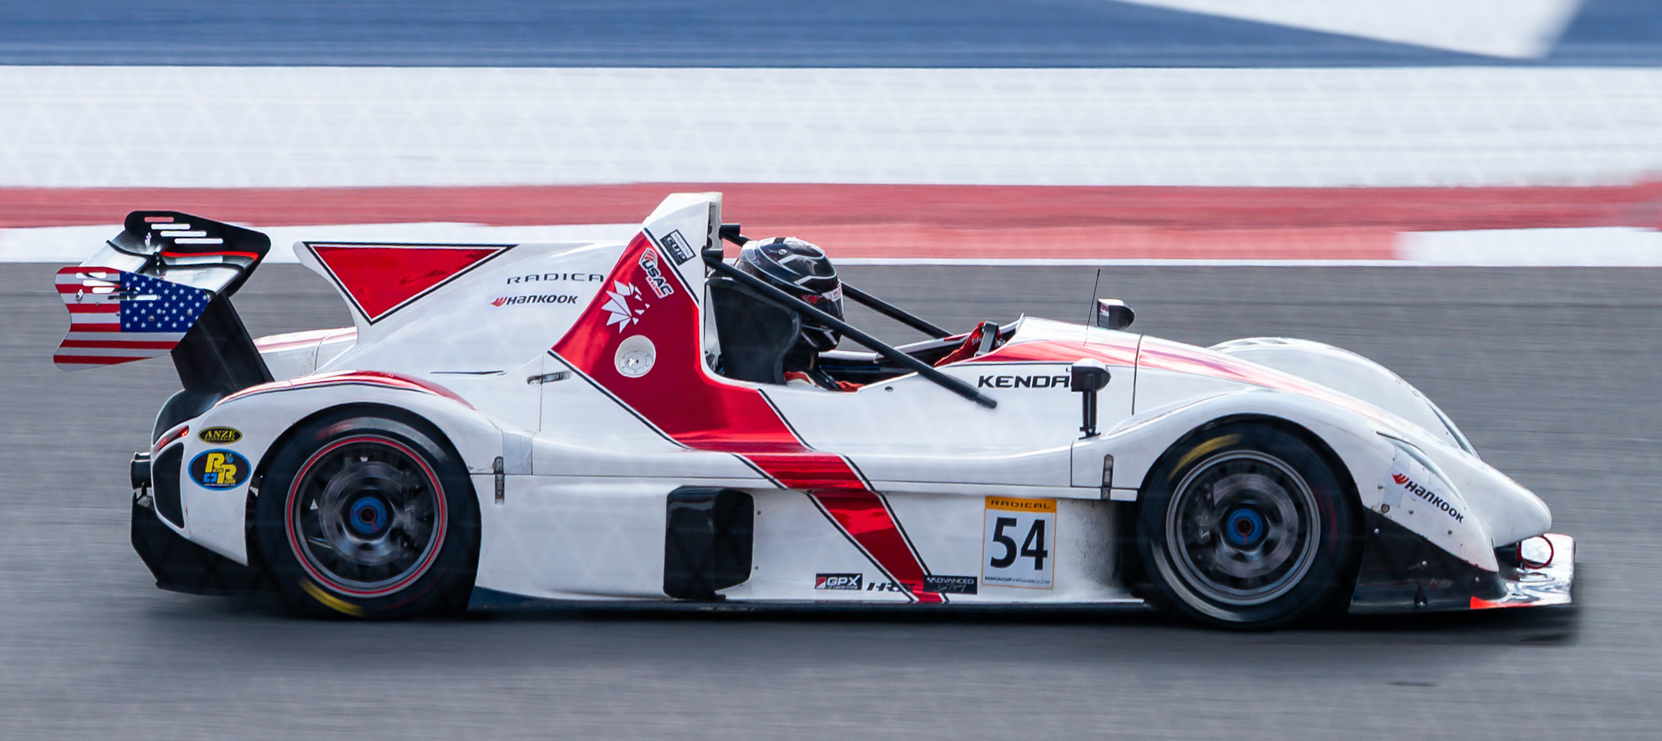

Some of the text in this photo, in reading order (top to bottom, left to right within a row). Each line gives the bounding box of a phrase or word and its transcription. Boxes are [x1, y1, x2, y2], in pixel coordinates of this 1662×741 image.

[666, 236, 686, 260] CUP
[506, 272, 605, 285] RADICA
[641, 259, 673, 296] USAC
[977, 375, 1070, 389] KENDA
[990, 499, 1052, 510] RADICAL
[990, 516, 1049, 572] 54
[826, 574, 861, 587] GPX
